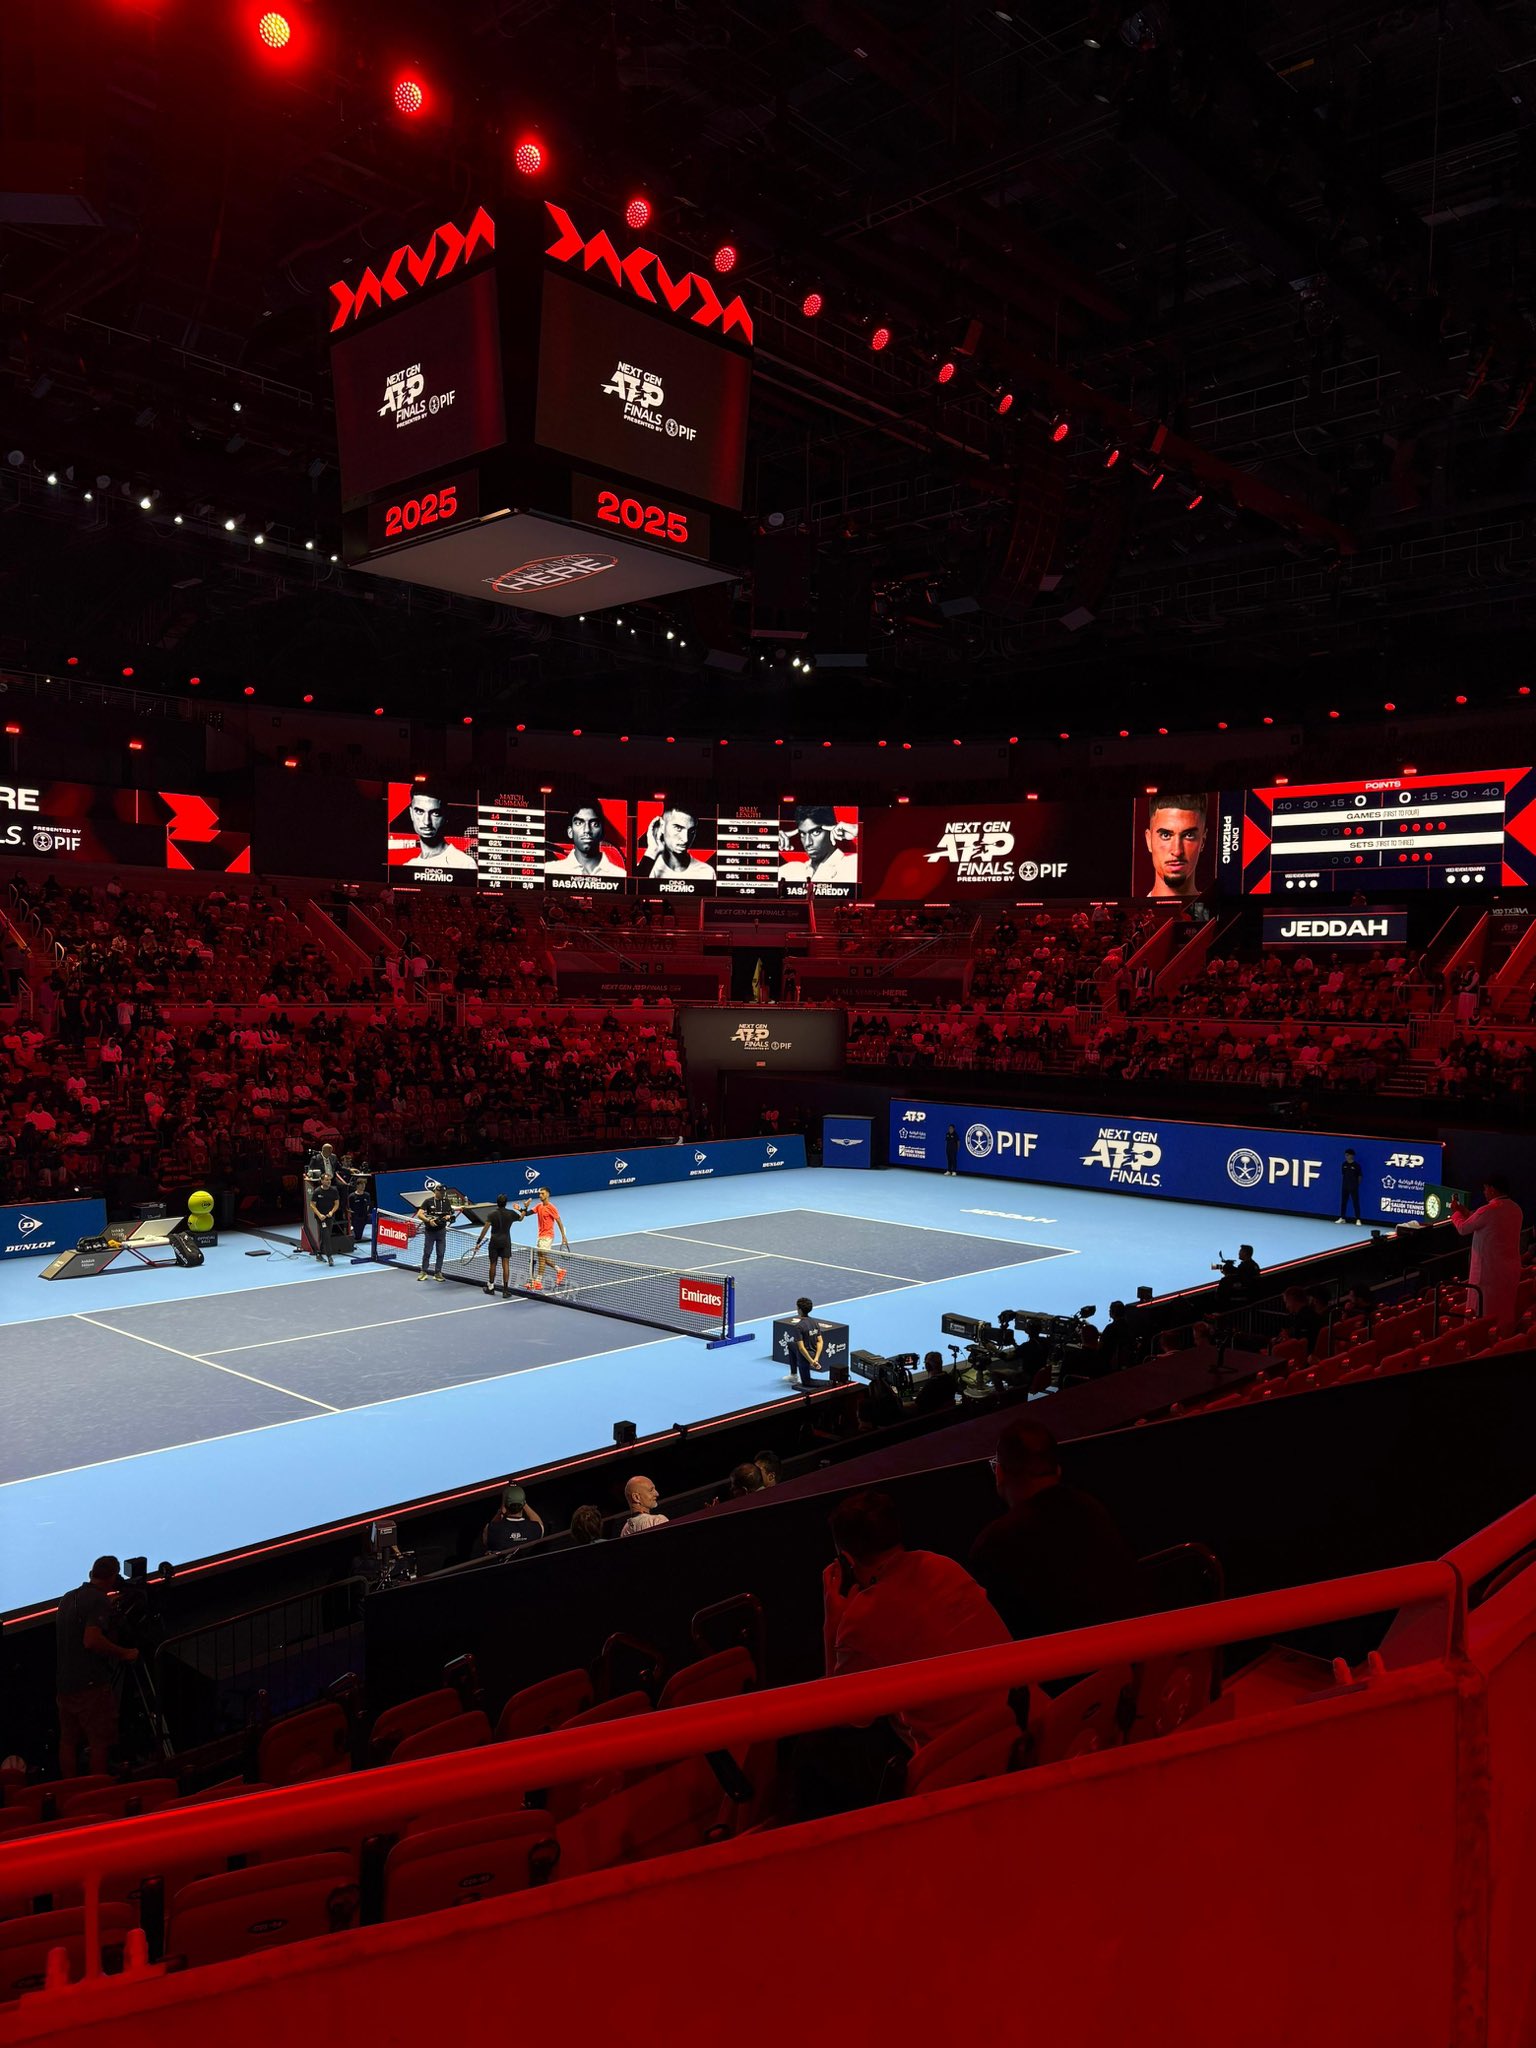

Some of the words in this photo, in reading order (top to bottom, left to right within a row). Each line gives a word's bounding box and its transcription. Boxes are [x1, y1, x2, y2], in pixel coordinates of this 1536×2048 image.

[387, 370, 405, 386] NEXT
[406, 363, 420, 378] GEN
[618, 361, 643, 378] NEXT
[644, 372, 662, 386] GEN
[377, 374, 424, 416] ATP
[600, 370, 664, 408] ATP
[440, 390, 455, 408] PIF
[396, 400, 426, 422] FINALS
[624, 402, 662, 425] FINALS
[624, 414, 654, 430] PRESENTED
[679, 424, 696, 441] PIF
[385, 486, 458, 537] 2025
[598, 491, 688, 543] 2025
[495, 558, 615, 590] HERE
[1365, 781, 1401, 790] POINTS
[494, 799, 529, 807] SUMMARY
[1355, 795, 1367, 806] 0
[1399, 792, 1412, 804] 0
[1422, 792, 1438, 801] 15
[1451, 790, 1468, 799] 30
[1482, 788, 1500, 796] 40
[1347, 812, 1381, 820] GAMES
[32, 826, 71, 834] PRESENTED
[945, 822, 981, 834] NEXT
[982, 821, 1010, 832] GEN
[54, 836, 81, 851] PIF
[923, 833, 1014, 862] ATP
[1222, 816, 1232, 864] PRIZMIC
[1232, 827, 1240, 852] DINO
[1040, 863, 1068, 878] PIF
[552, 880, 619, 891] BASAVAREDDY
[1281, 920, 1388, 937] JEDDAH
[730, 1029, 770, 1042] ATP
[902, 1111, 926, 1122] ATP
[997, 1130, 1038, 1158] PIF
[1098, 1128, 1130, 1141] NEXT
[1133, 1131, 1158, 1143] GEN
[1078, 1139, 1162, 1170] ATP
[1384, 1153, 1424, 1168] ATP
[1268, 1156, 1322, 1188] PIF
[379, 1225, 407, 1241] Emirates
[6, 1240, 56, 1252] DUNLOP
[681, 1287, 722, 1306] Emirates
